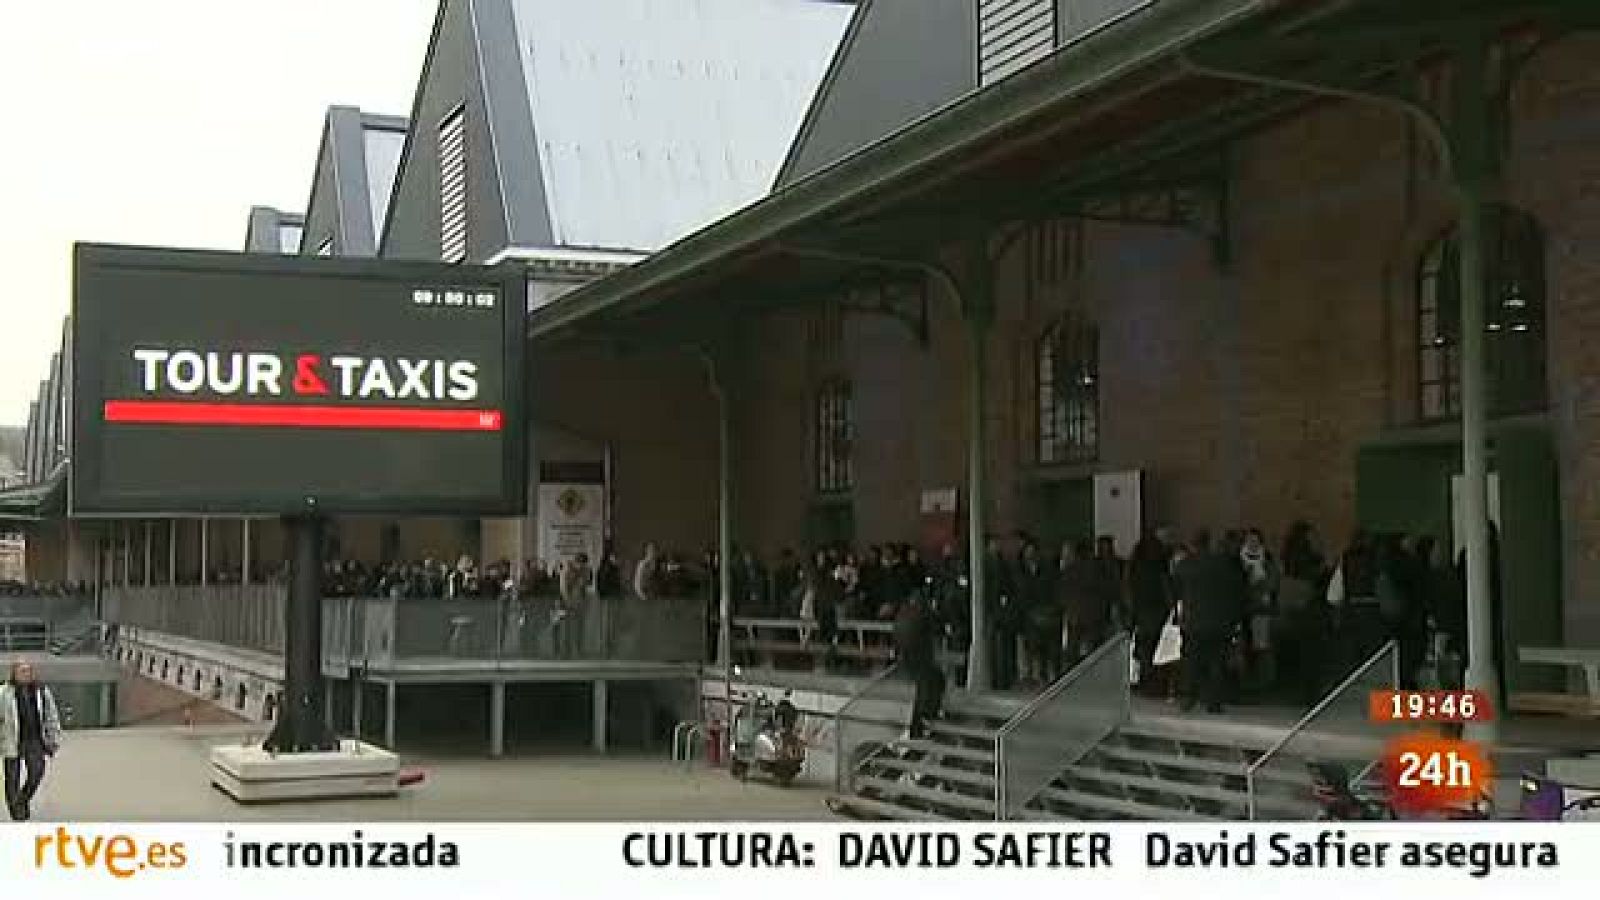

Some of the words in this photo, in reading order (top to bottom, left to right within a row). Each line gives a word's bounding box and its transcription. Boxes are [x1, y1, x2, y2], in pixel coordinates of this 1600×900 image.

[134, 349, 282, 394] TOUR
[293, 354, 328, 394] &
[331, 356, 479, 400] TAXIS
